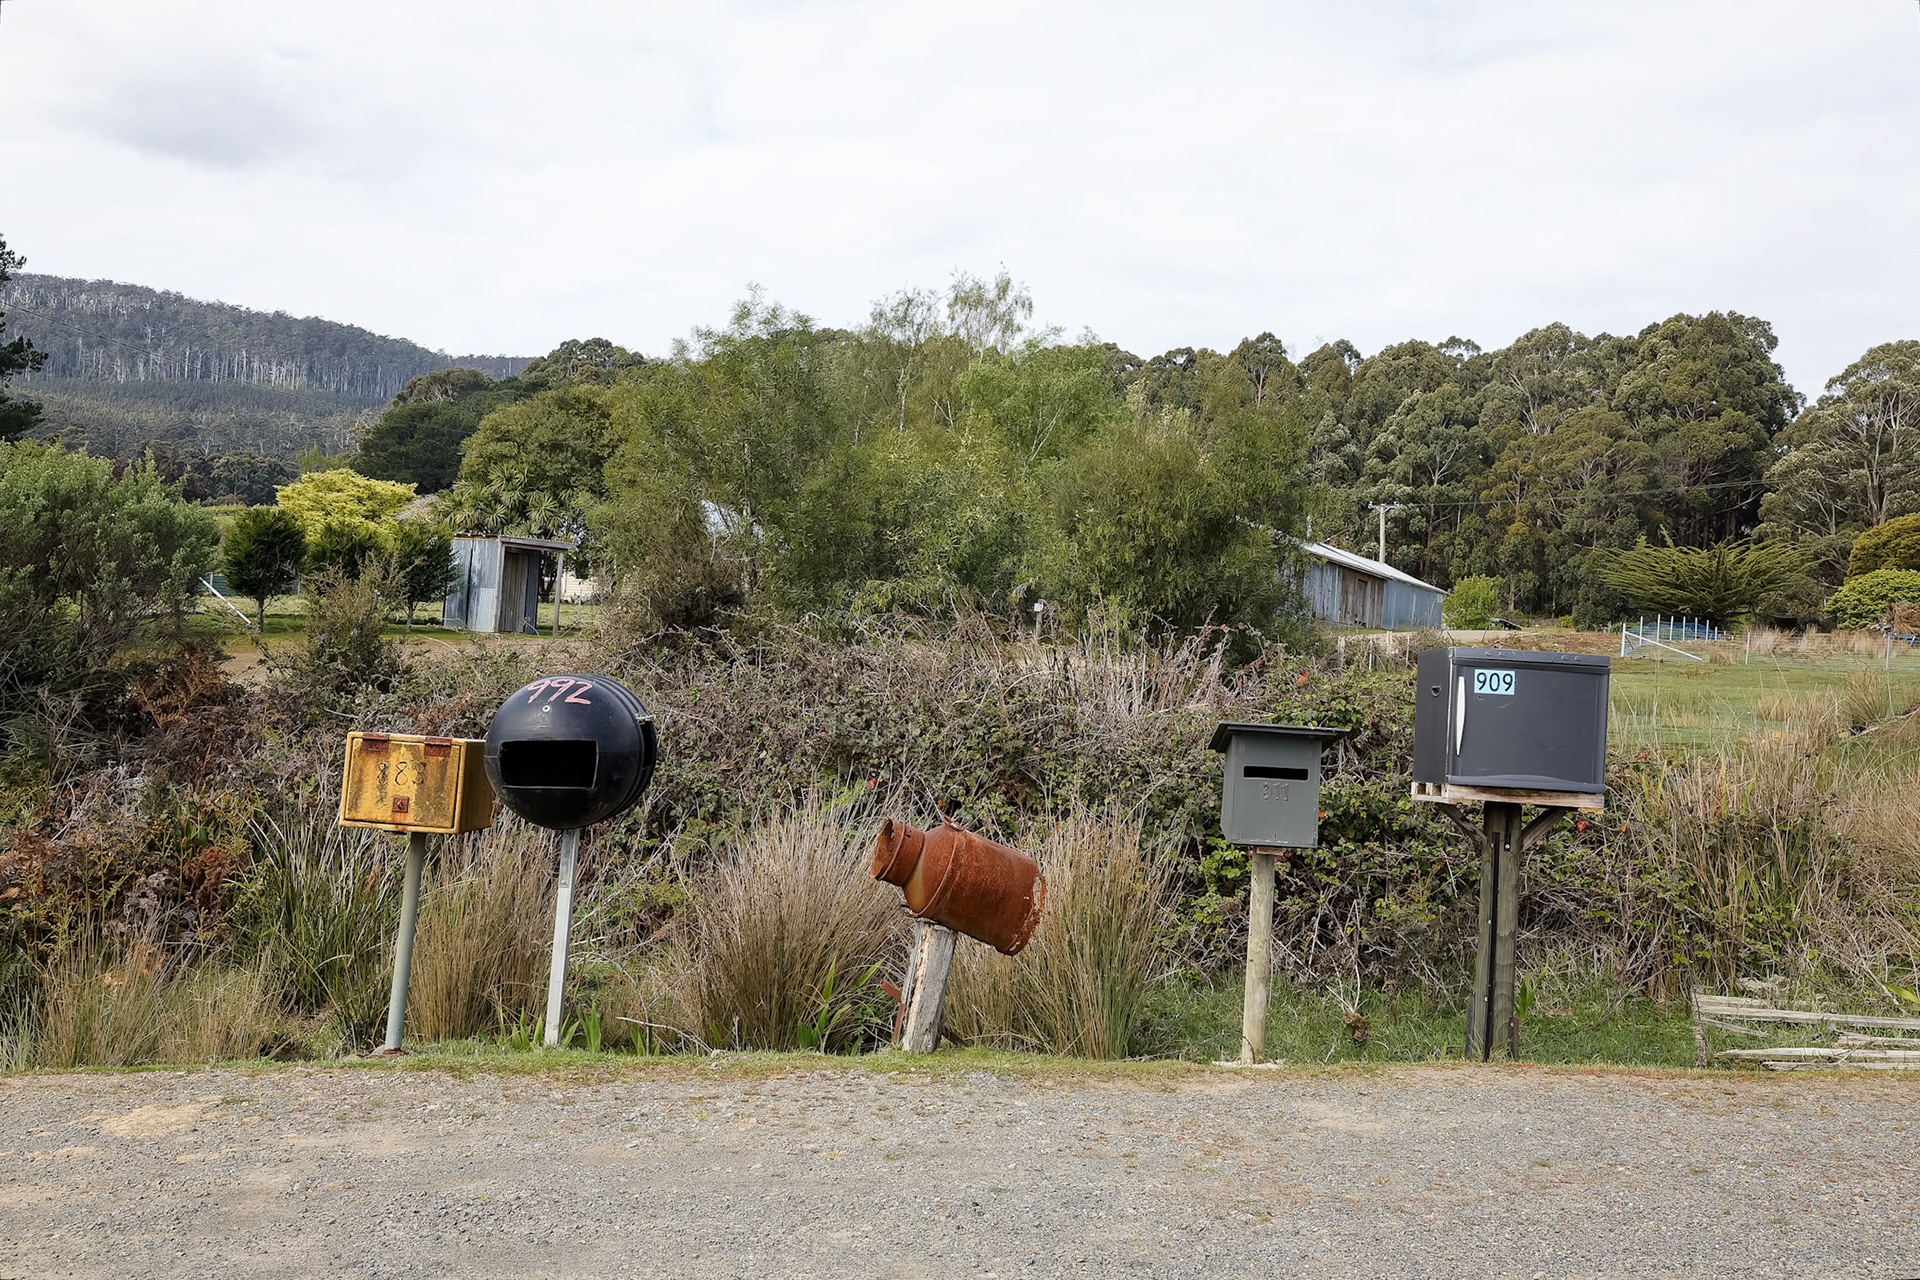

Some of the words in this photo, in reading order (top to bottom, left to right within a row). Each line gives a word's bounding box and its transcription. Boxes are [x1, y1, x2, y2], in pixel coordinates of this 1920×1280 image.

[527, 678, 593, 705] 992
[1476, 672, 1514, 692] 909
[1260, 781, 1289, 802] 911
